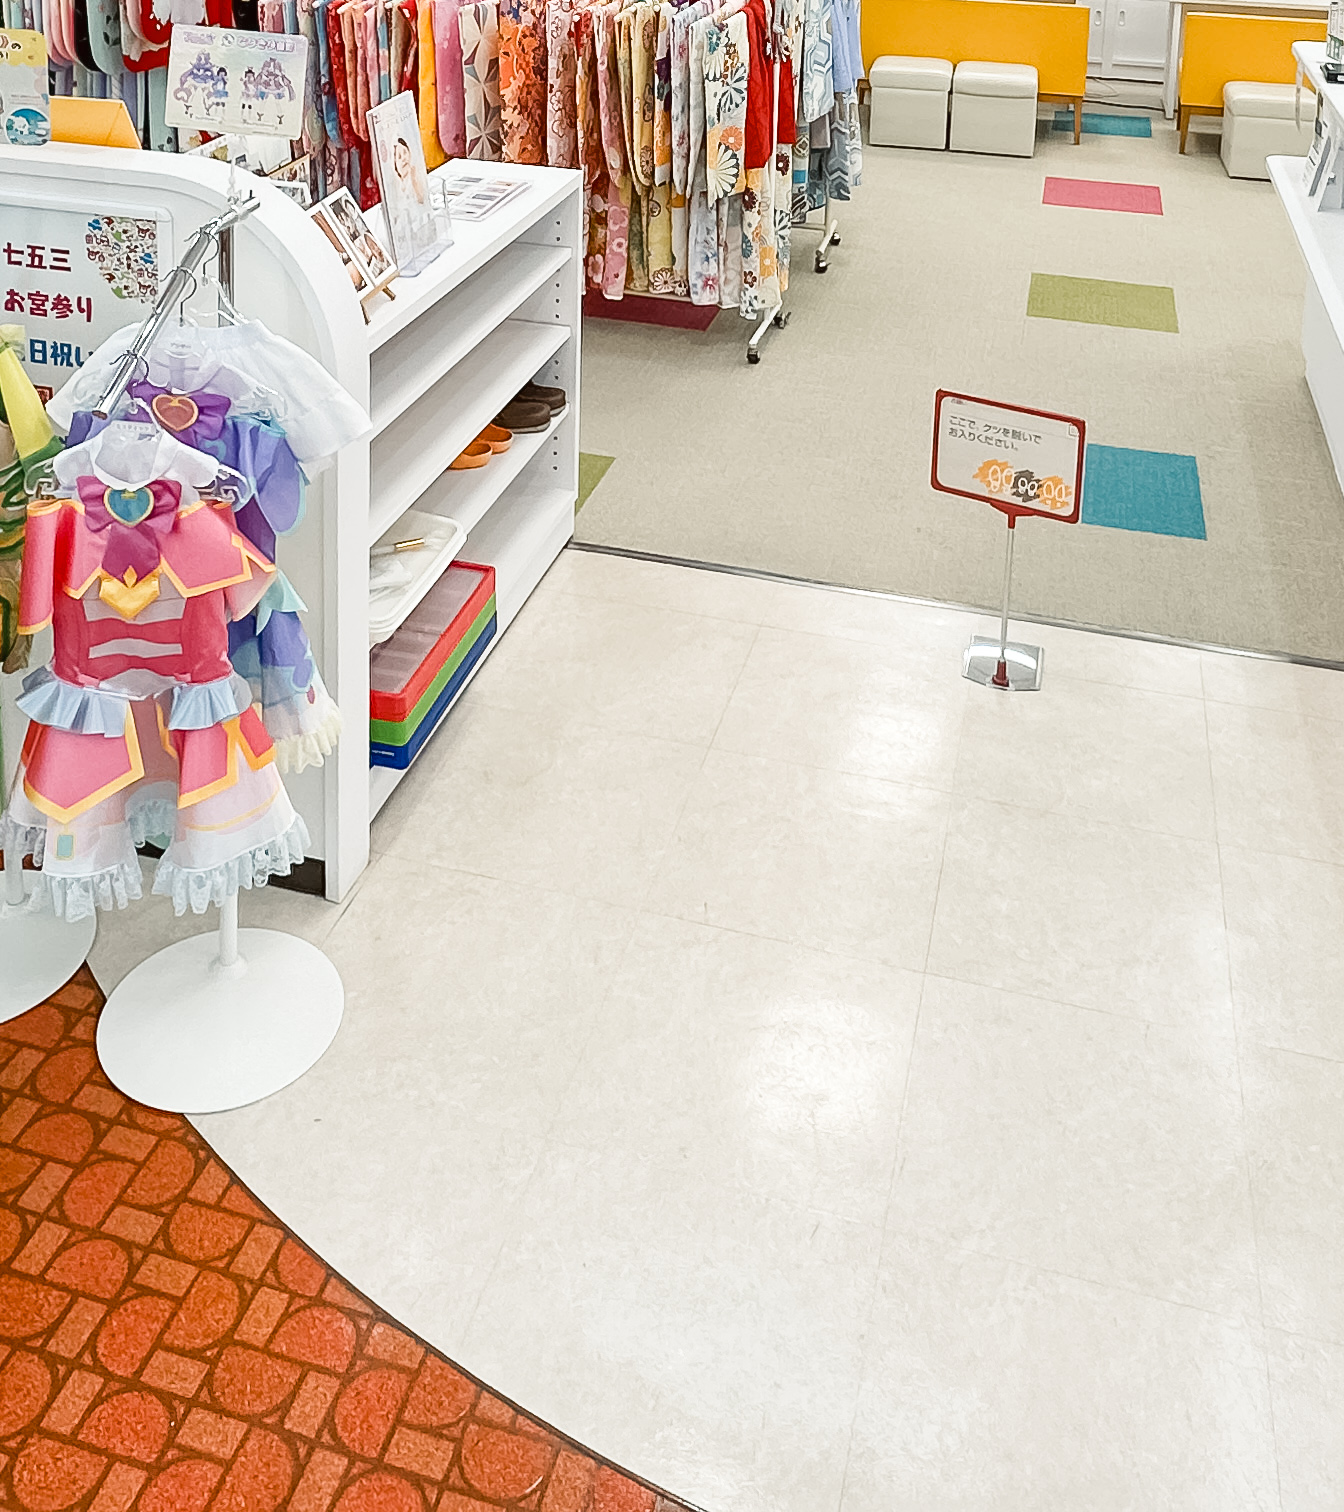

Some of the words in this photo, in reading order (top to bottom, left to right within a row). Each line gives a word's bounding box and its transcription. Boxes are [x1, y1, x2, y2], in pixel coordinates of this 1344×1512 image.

[2, 242, 72, 272] 七五三
[4, 288, 92, 323] お宮参り
[18, 338, 95, 368] 日祝い
